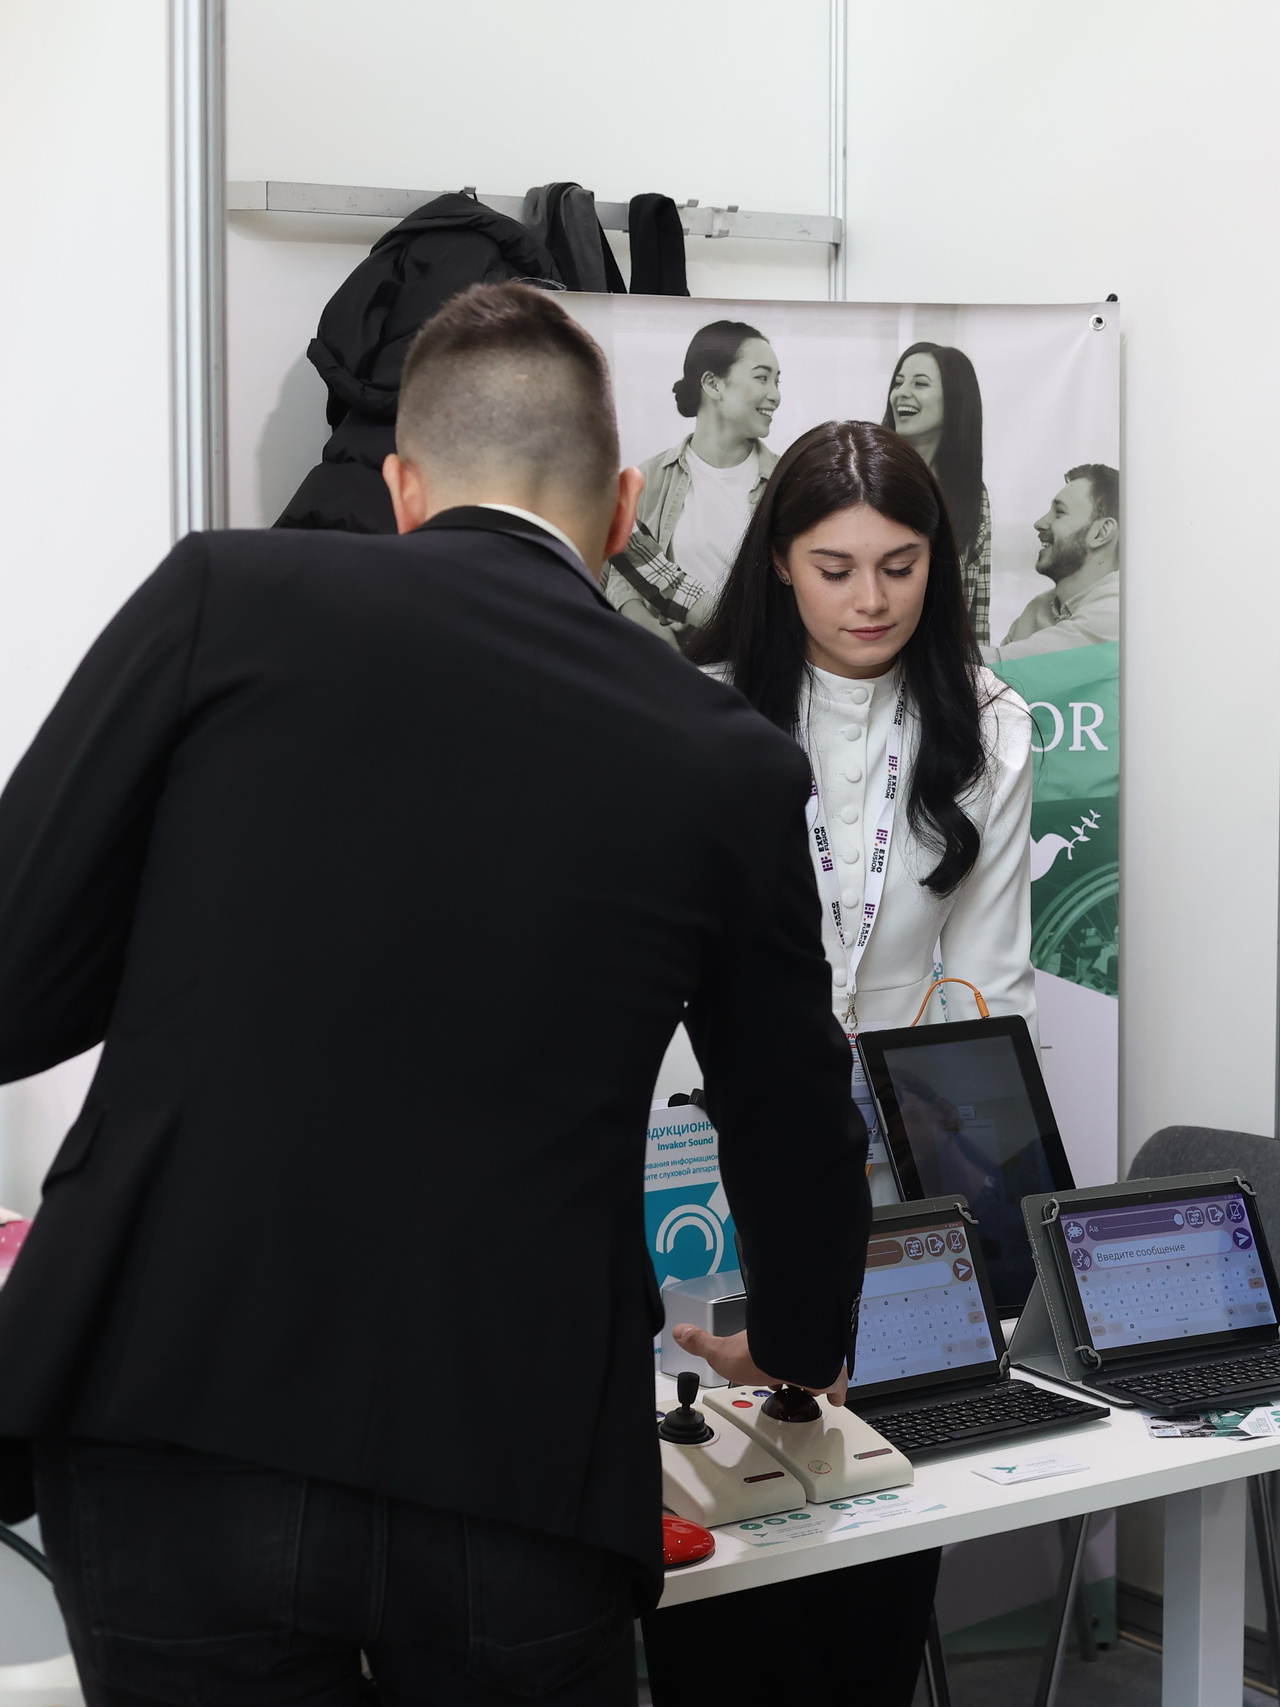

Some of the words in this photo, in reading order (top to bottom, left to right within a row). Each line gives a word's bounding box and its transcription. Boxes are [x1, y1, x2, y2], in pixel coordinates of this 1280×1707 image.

[1029, 701, 1109, 752] OR
[885, 774, 893, 799] FUSION
[889, 774, 897, 800] EXPO
[814, 827, 825, 853] EXPO
[820, 826, 830, 851] FUSION
[870, 847, 879, 873] FUSION
[876, 849, 885, 874] EXPO
[857, 922, 867, 947] FUSION
[861, 923, 871, 947] EXPO
[657, 1141, 687, 1151] Invakor
[688, 1136, 714, 1147] Sound
[659, 1167, 691, 1179] слуховой
[1096, 1250, 1135, 1262] Введите
[1135, 1243, 1186, 1257] сообщение
